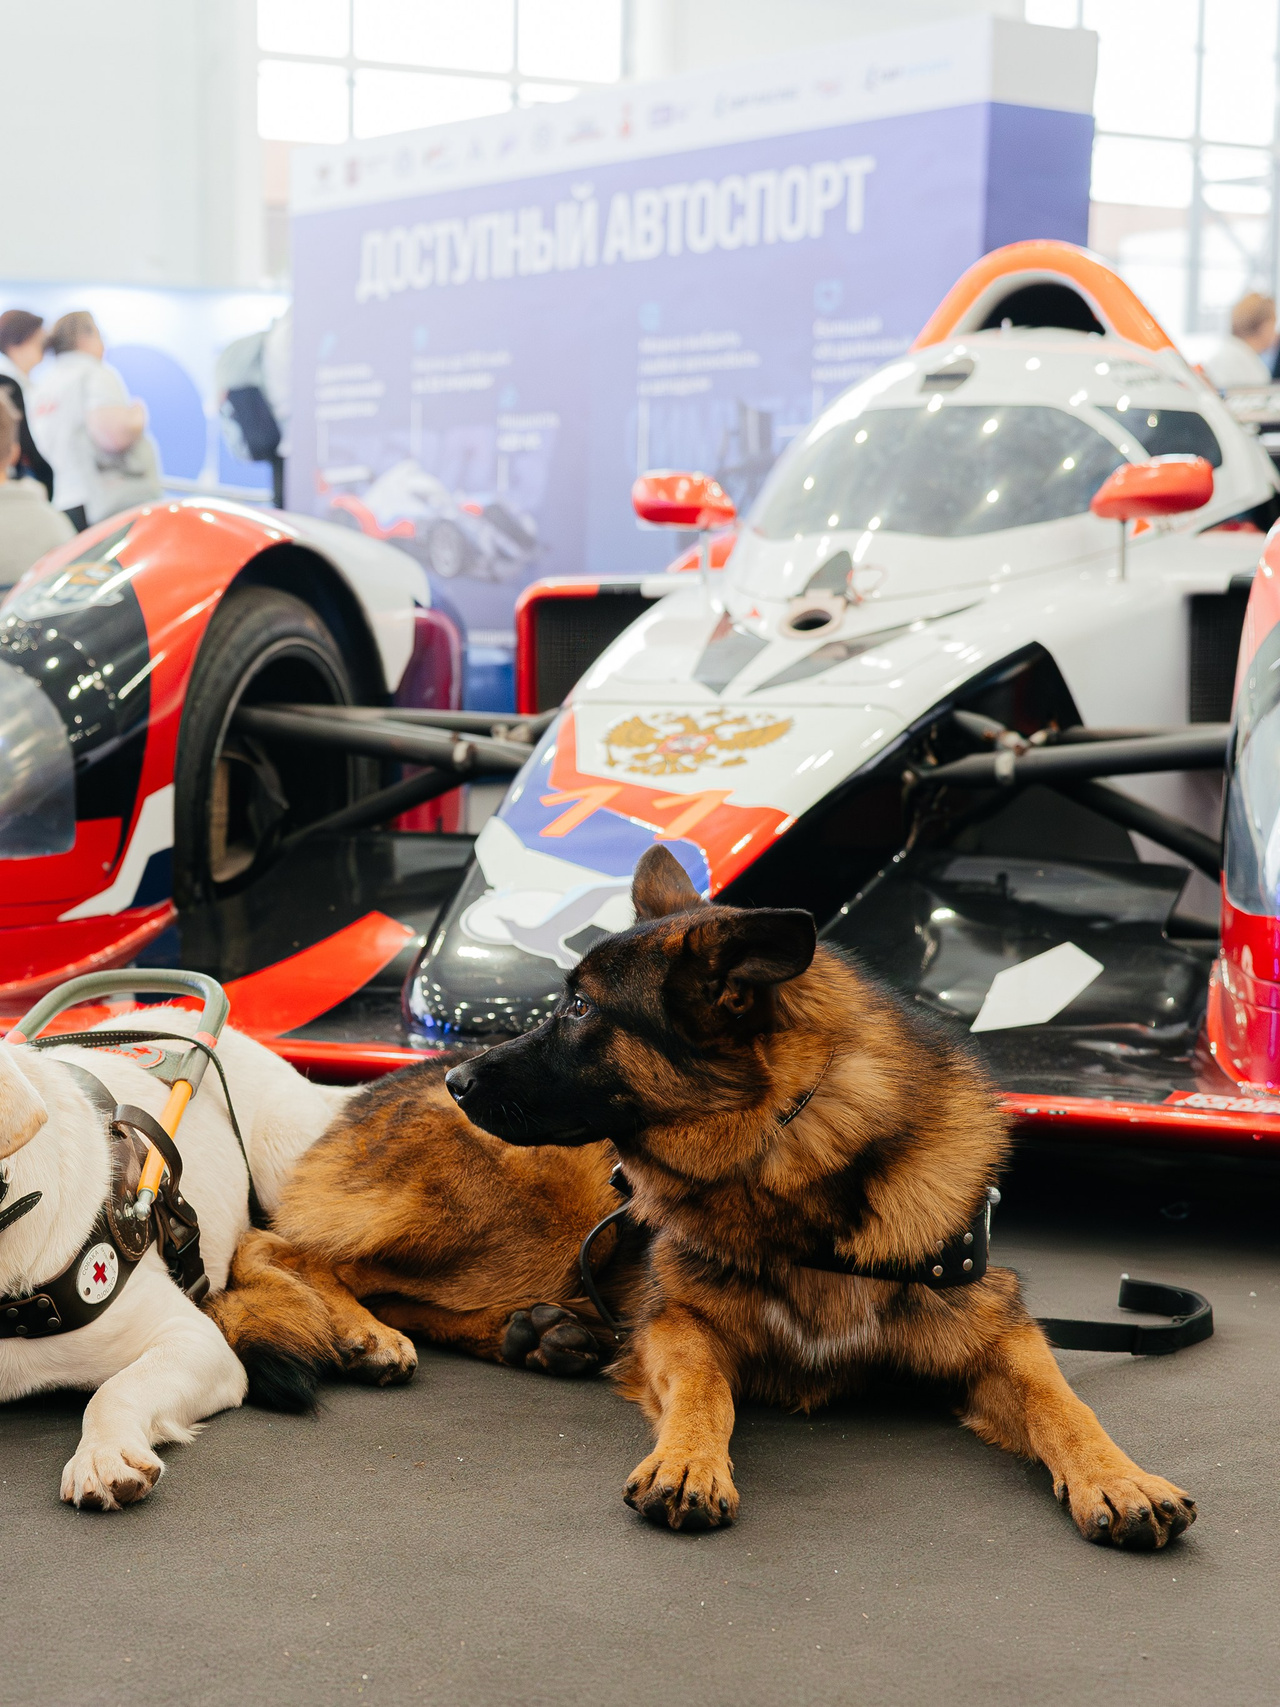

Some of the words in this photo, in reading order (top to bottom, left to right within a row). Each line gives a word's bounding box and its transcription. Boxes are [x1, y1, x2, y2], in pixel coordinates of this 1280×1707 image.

[356, 182, 599, 304] ДОСТУПНЫЙ
[602, 154, 877, 265] АВТОСПОРТ
[539, 785, 734, 841] 11
[82, 1250, 99, 1276] СОБАКА
